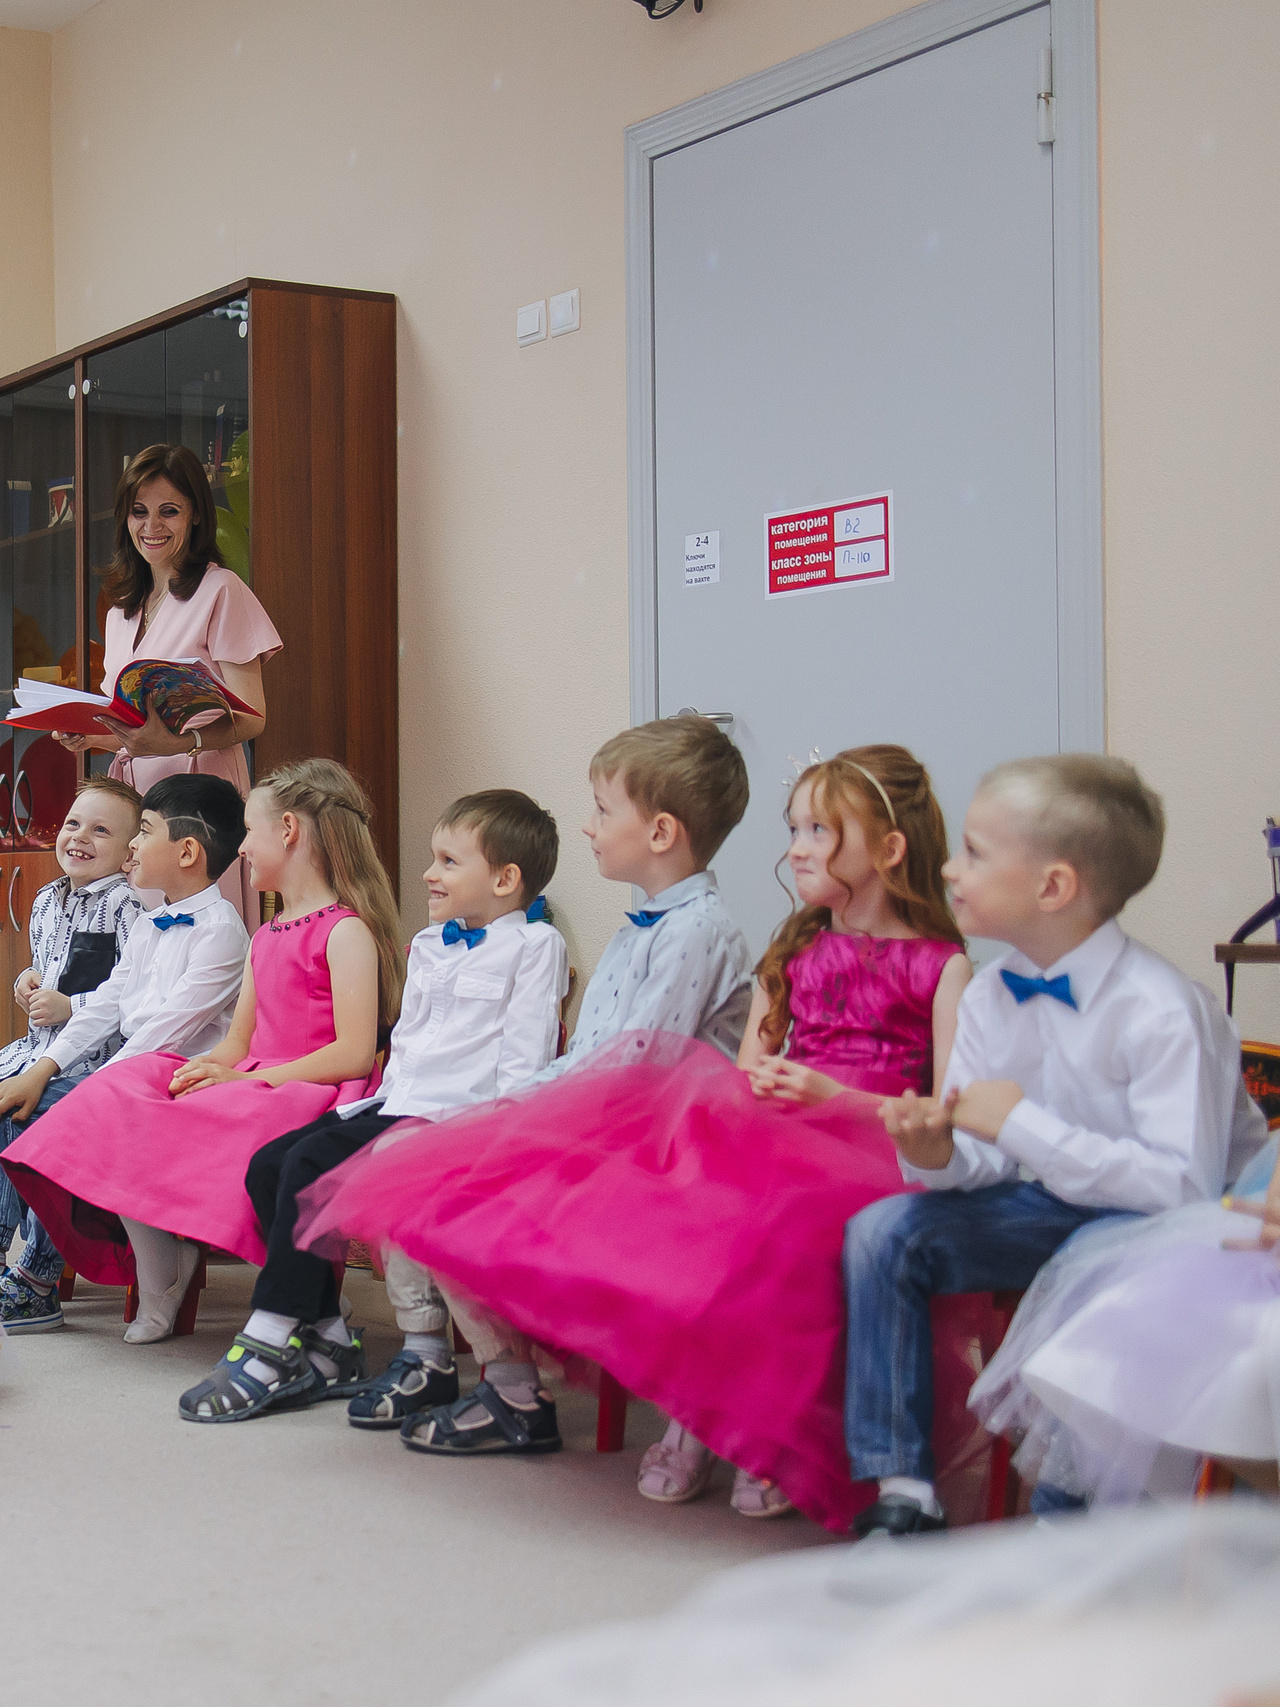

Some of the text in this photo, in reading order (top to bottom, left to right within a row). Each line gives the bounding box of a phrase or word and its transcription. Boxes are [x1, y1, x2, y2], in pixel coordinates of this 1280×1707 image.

[771, 515, 828, 536] категория
[695, 535, 709, 547] 2-4
[774, 532, 828, 550] помещения
[685, 553, 706, 561] Ключи
[771, 550, 833, 571] класс зоны
[685, 563, 716, 573] находятся
[694, 576, 710, 584] вахте
[776, 568, 827, 585] помещения
